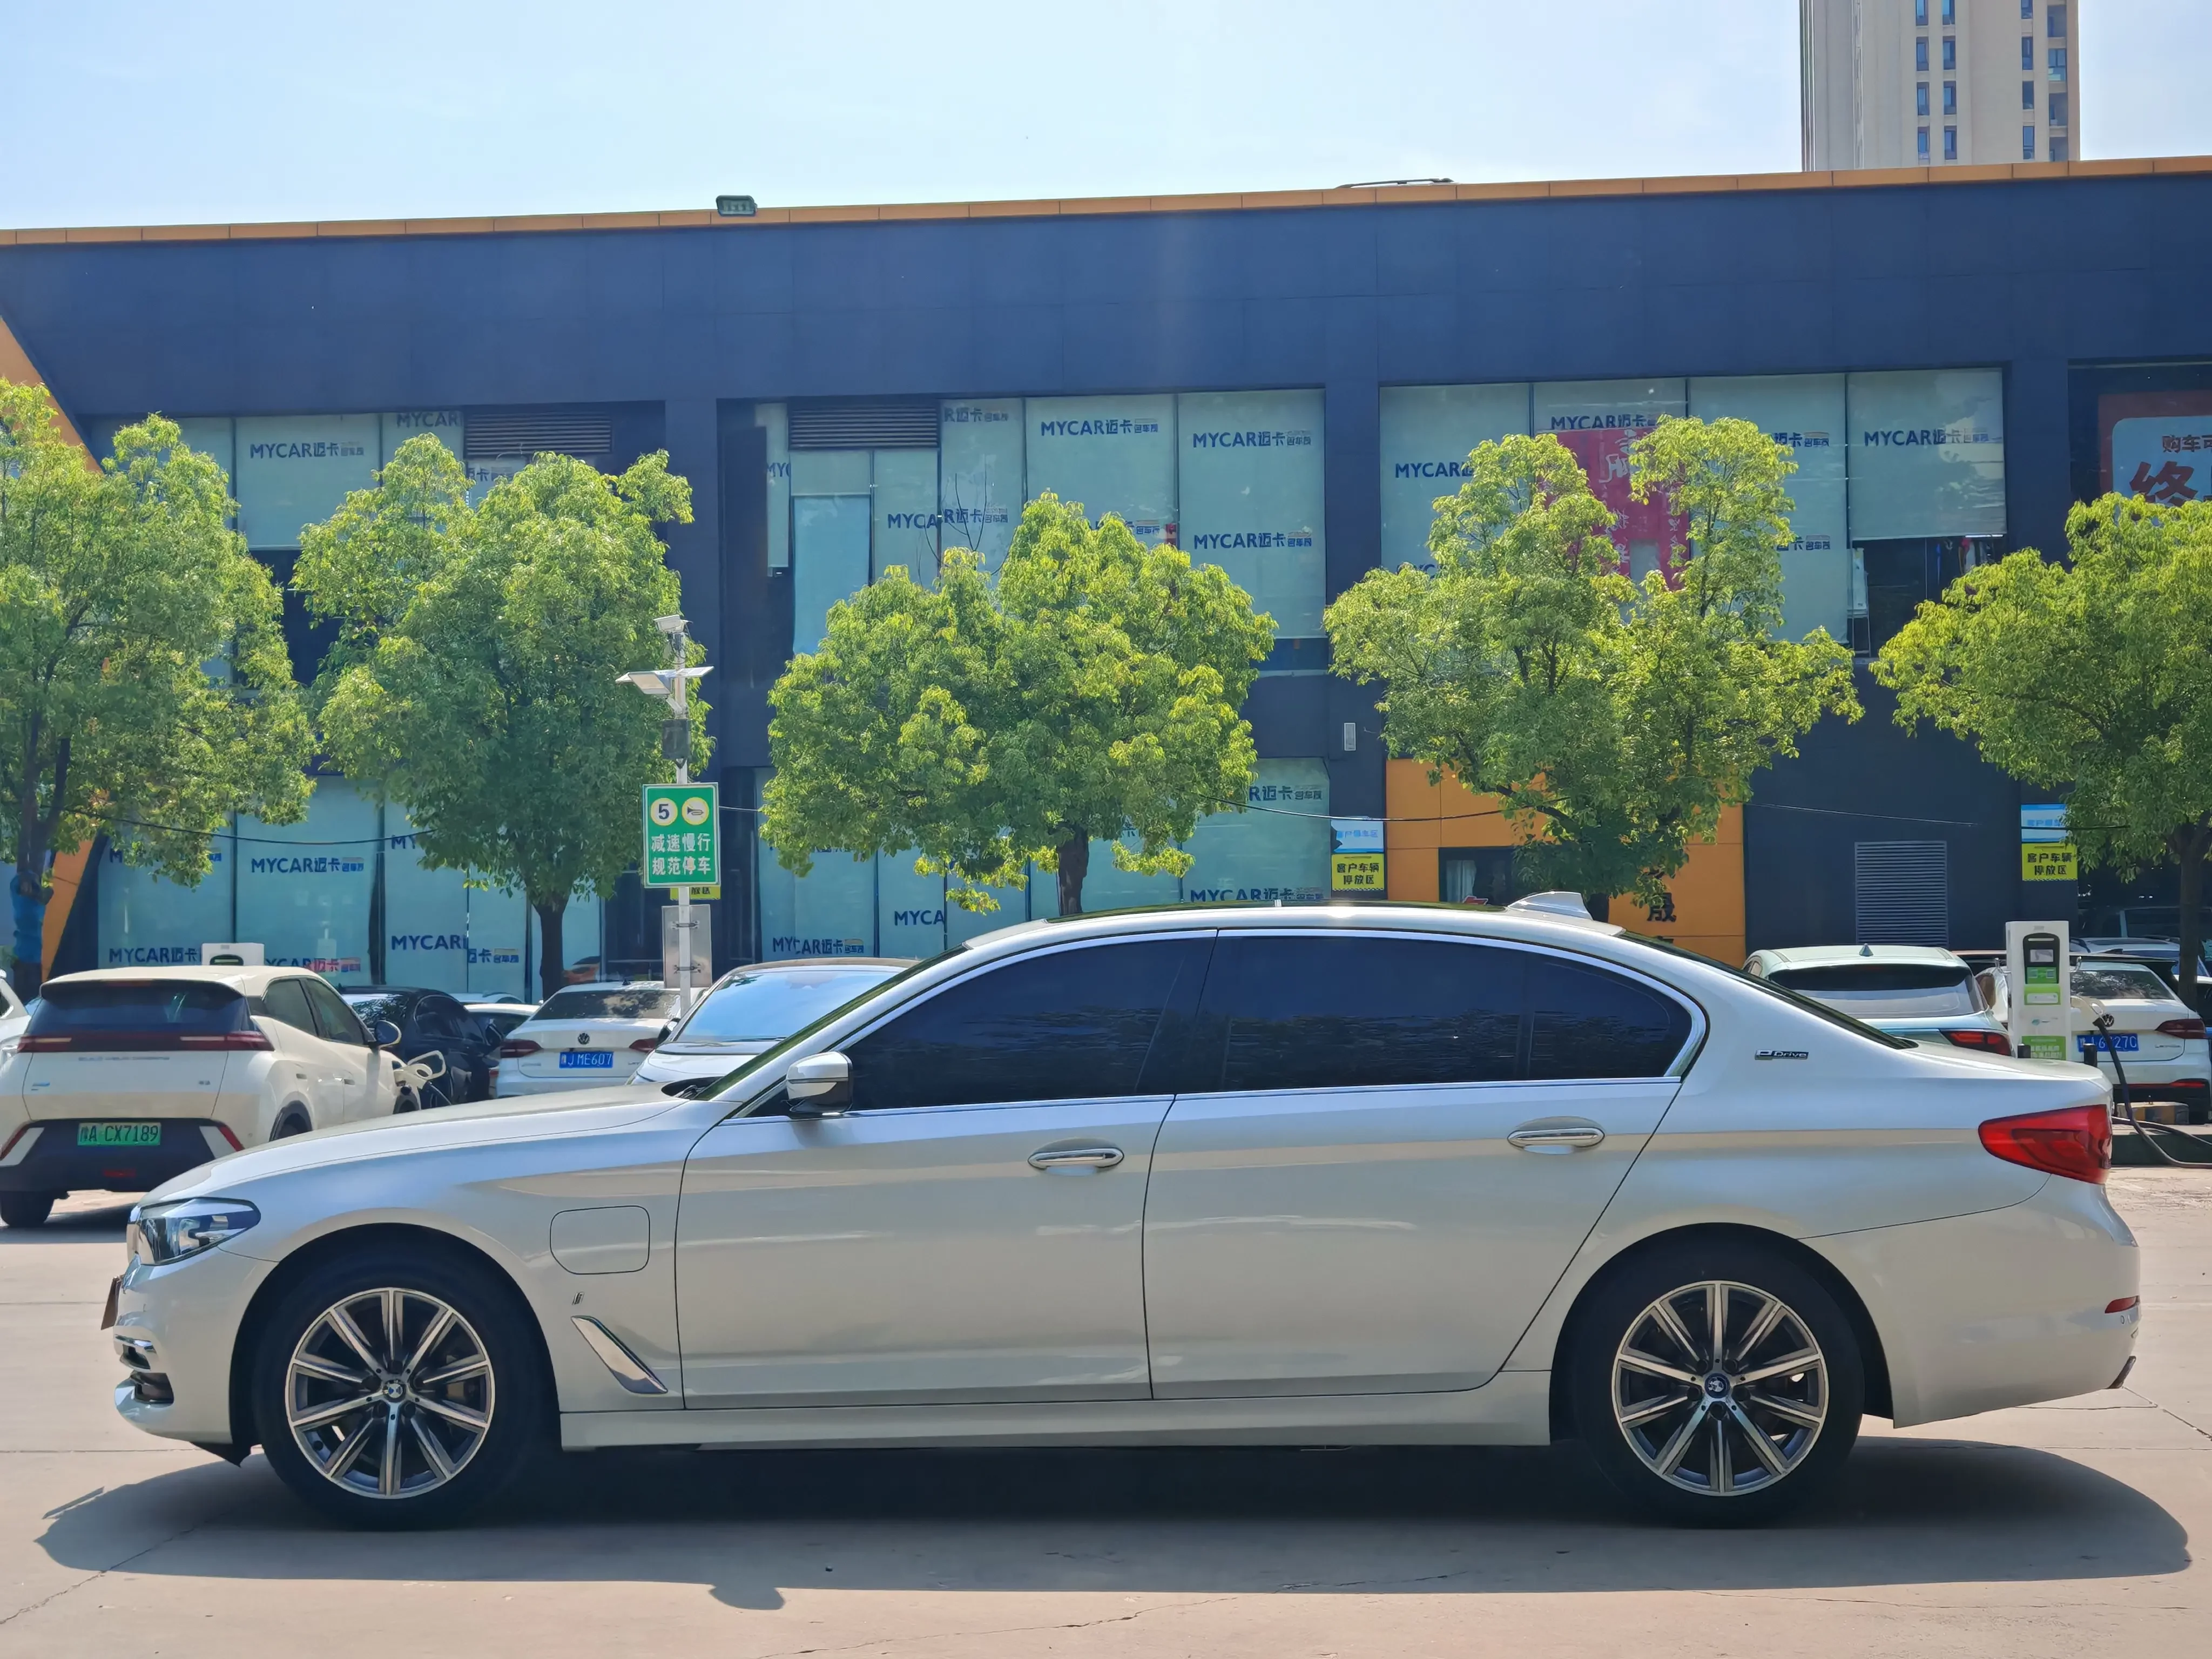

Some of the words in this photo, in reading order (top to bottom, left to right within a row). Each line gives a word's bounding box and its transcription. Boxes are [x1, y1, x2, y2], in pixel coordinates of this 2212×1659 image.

[1041, 420, 1105, 436] MYCAR
[1551, 415, 1616, 430] MYCAR
[1193, 431, 1257, 448] MYCAR
[1864, 430, 1932, 446] MYCAR
[250, 443, 313, 458] MYCAR
[1395, 462, 1460, 478] MYCAR
[2130, 461, 2212, 507] 终
[1193, 532, 1257, 550] MYCAR
[658, 804, 670, 820] 5
[651, 833, 711, 852] 减速慢行
[252, 857, 313, 873] MYCAR
[652, 856, 711, 875] 规范停车
[2034, 865, 2067, 875] 停放区
[1343, 874, 1374, 885] 停放区
[391, 934, 461, 950] MYCAR
[109, 948, 170, 963] MYCAR
[105, 1125, 159, 1142] CX7189
